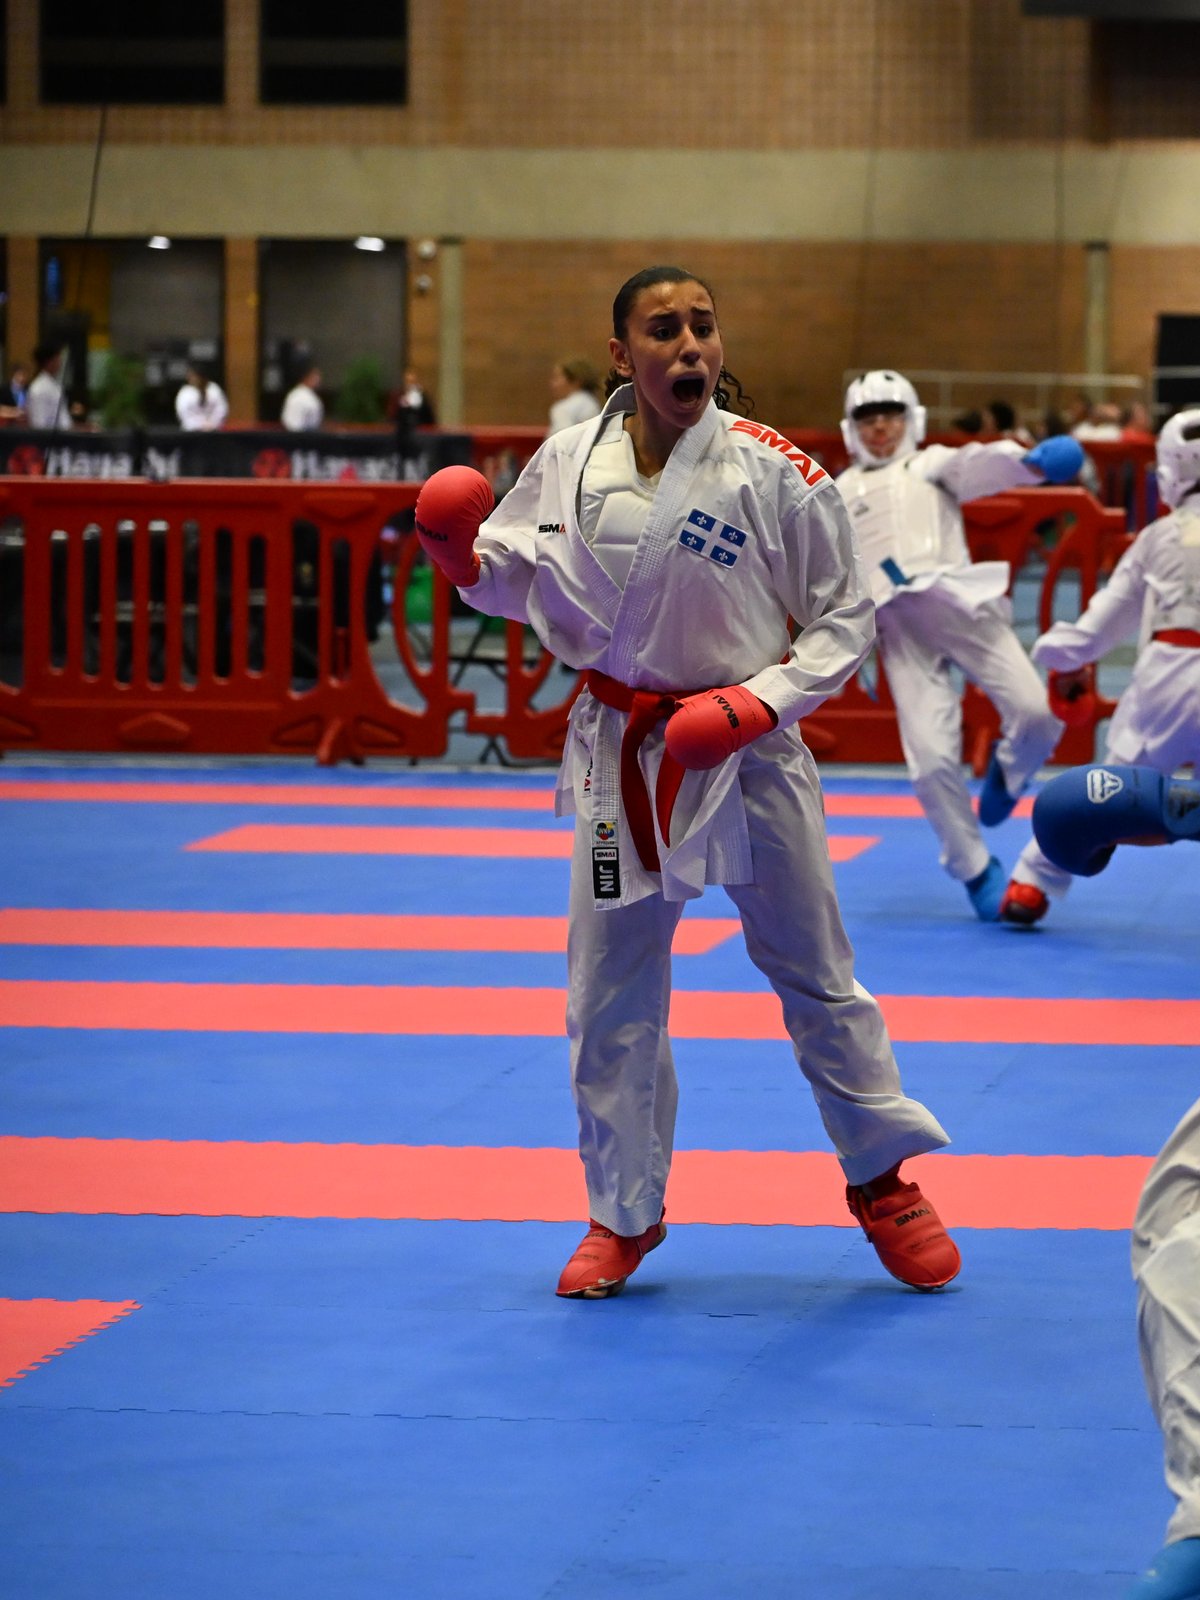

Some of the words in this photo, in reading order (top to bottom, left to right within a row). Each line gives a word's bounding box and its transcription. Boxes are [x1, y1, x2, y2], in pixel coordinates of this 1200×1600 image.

[728, 420, 826, 487] SMAI
[713, 695, 740, 729] SMAI
[599, 865, 615, 892] JIN
